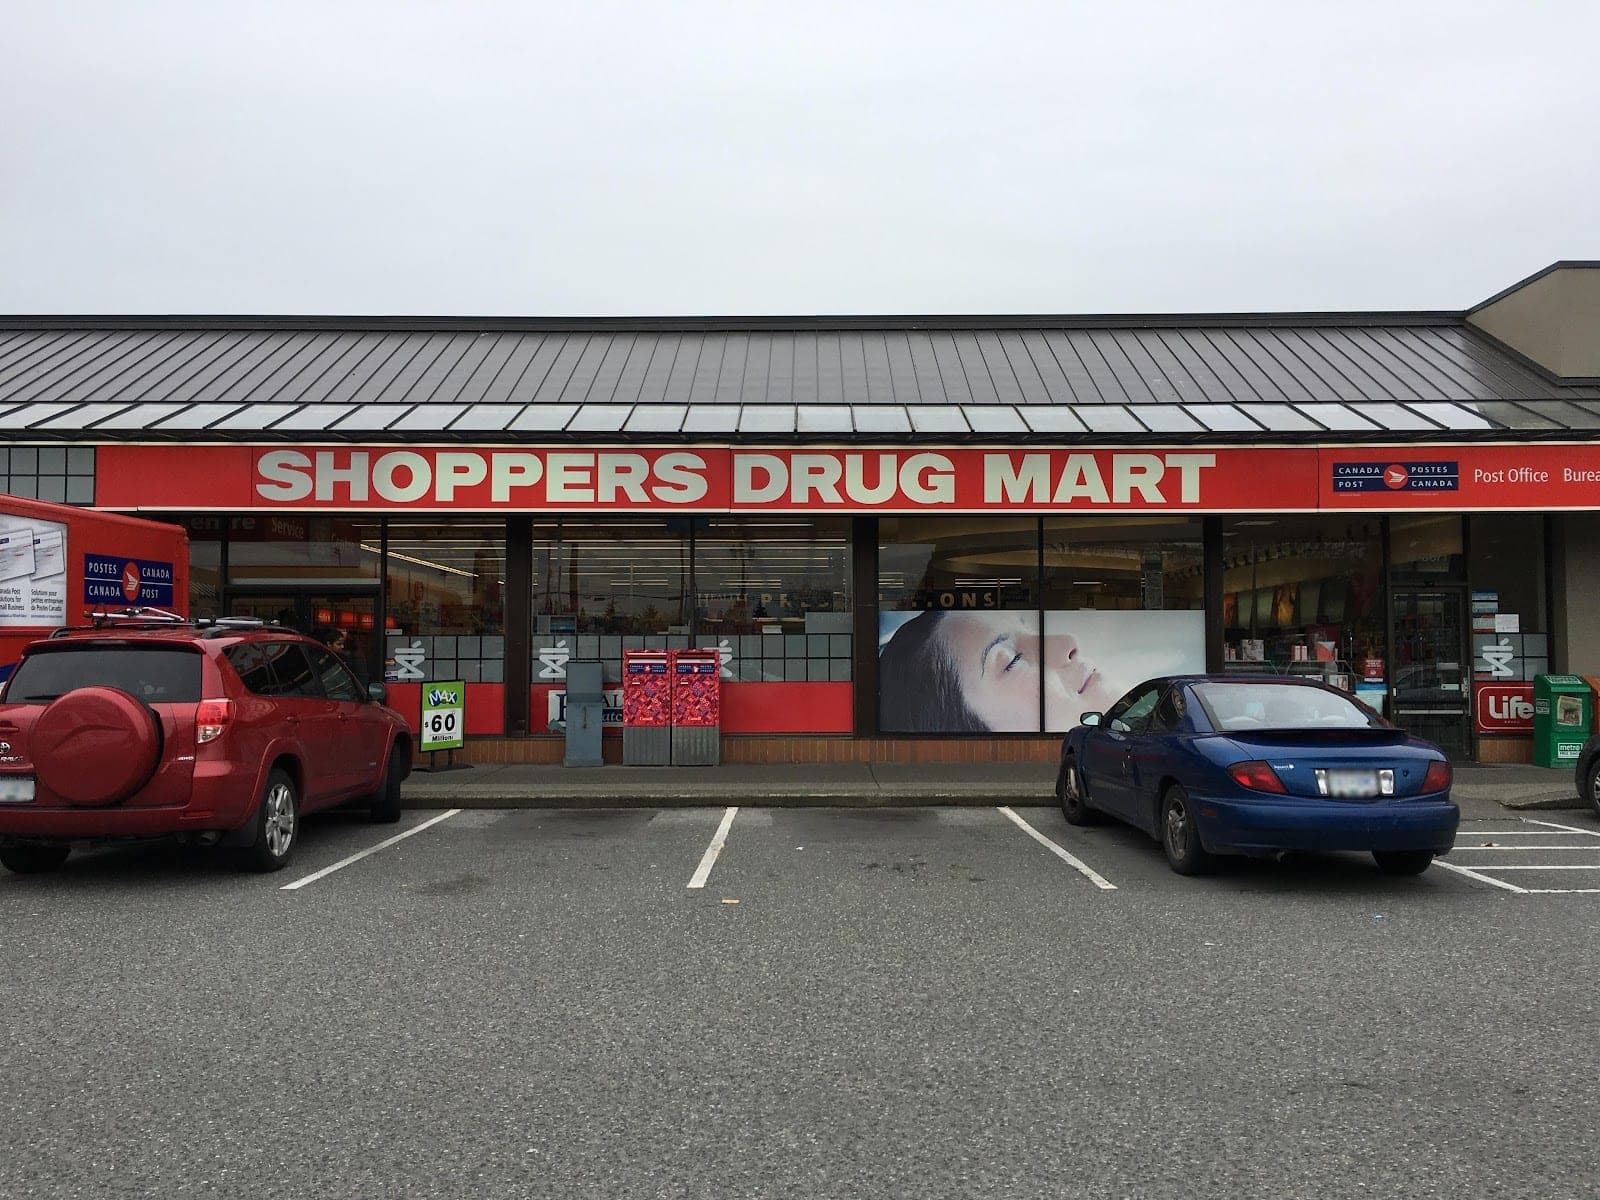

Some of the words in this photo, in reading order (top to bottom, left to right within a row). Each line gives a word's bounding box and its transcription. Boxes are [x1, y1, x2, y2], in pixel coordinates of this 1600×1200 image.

[255, 450, 708, 503] SHOPPERS
[733, 452, 955, 504] DRUG
[984, 453, 1216, 504] MART
[1338, 467, 1380, 475] CANADA
[1474, 468, 1505, 483] Post
[1508, 467, 1549, 483] Office
[1563, 468, 1600, 482] Burea
[1338, 480, 1363, 488] POST
[88, 562, 117, 574] POSTES
[142, 567, 170, 579] CANADA
[88, 585, 121, 597] CANADA
[141, 588, 159, 599] POST
[428, 689, 456, 706] MAX
[1488, 696, 1535, 719] Life
